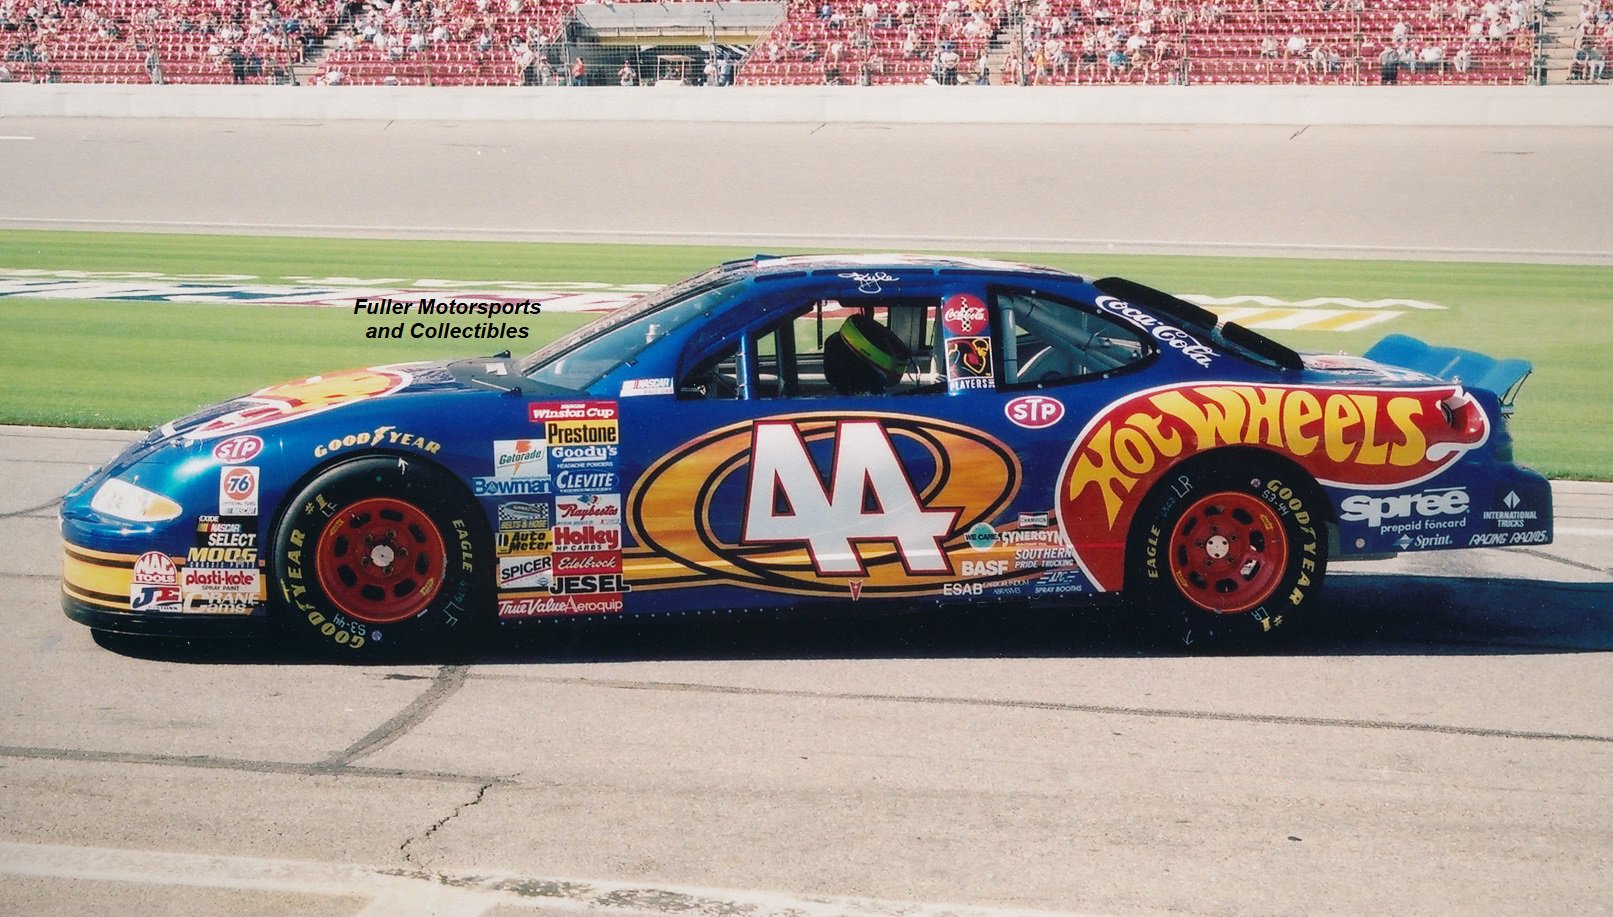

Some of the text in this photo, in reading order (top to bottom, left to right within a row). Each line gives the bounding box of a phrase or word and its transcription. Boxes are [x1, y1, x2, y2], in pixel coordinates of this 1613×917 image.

[838, 271, 899, 294] Kyle
[1095, 295, 1222, 368] Coca-Cola
[949, 379, 987, 391] PLAYERS
[533, 407, 614, 419] Winston Cup
[1014, 400, 1056, 420] STP
[548, 423, 617, 444] Prestone
[218, 438, 257, 458] STP
[314, 427, 441, 458] GOODYEAR
[499, 449, 542, 465] Gatorade
[552, 445, 618, 461] Goody's
[227, 474, 251, 493] 76
[474, 478, 550, 494] Bowman
[556, 470, 615, 489] CLEVITE
[1171, 475, 1193, 498] LR
[741, 420, 966, 578] 44
[322, 502, 338, 518] LF
[557, 504, 619, 520] Raybestos
[1483, 510, 1537, 519] INTERNATIONAL
[210, 524, 241, 532] NASCAR
[1381, 522, 1421, 535] prepaid
[1497, 520, 1524, 528] TRUCKS
[208, 533, 256, 546] SELECT
[511, 531, 546, 541] Auto
[554, 526, 619, 547] Holley
[965, 533, 977, 541] WE
[1267, 479, 1317, 605] GOODYEAR
[1414, 534, 1452, 548] Sprint
[1469, 530, 1547, 545] RACING RADIOS
[452, 519, 473, 573] EAGLE
[511, 540, 552, 551] Meter
[1146, 525, 1161, 578] EAGLE
[187, 547, 258, 562] MOOG
[1015, 548, 1072, 560] SOUTHERN
[136, 553, 175, 574] MAC
[501, 557, 551, 580] SPICER
[558, 556, 617, 571] Edelbrock
[962, 560, 1008, 576] BASF
[1015, 560, 1038, 568] PRIDE
[136, 574, 175, 582] TOOLS
[186, 570, 254, 586] plasti-kote
[550, 575, 631, 594] JESEL
[943, 583, 983, 595] ESAB
[132, 587, 180, 609] JE
[565, 596, 623, 613] Aeroquip
